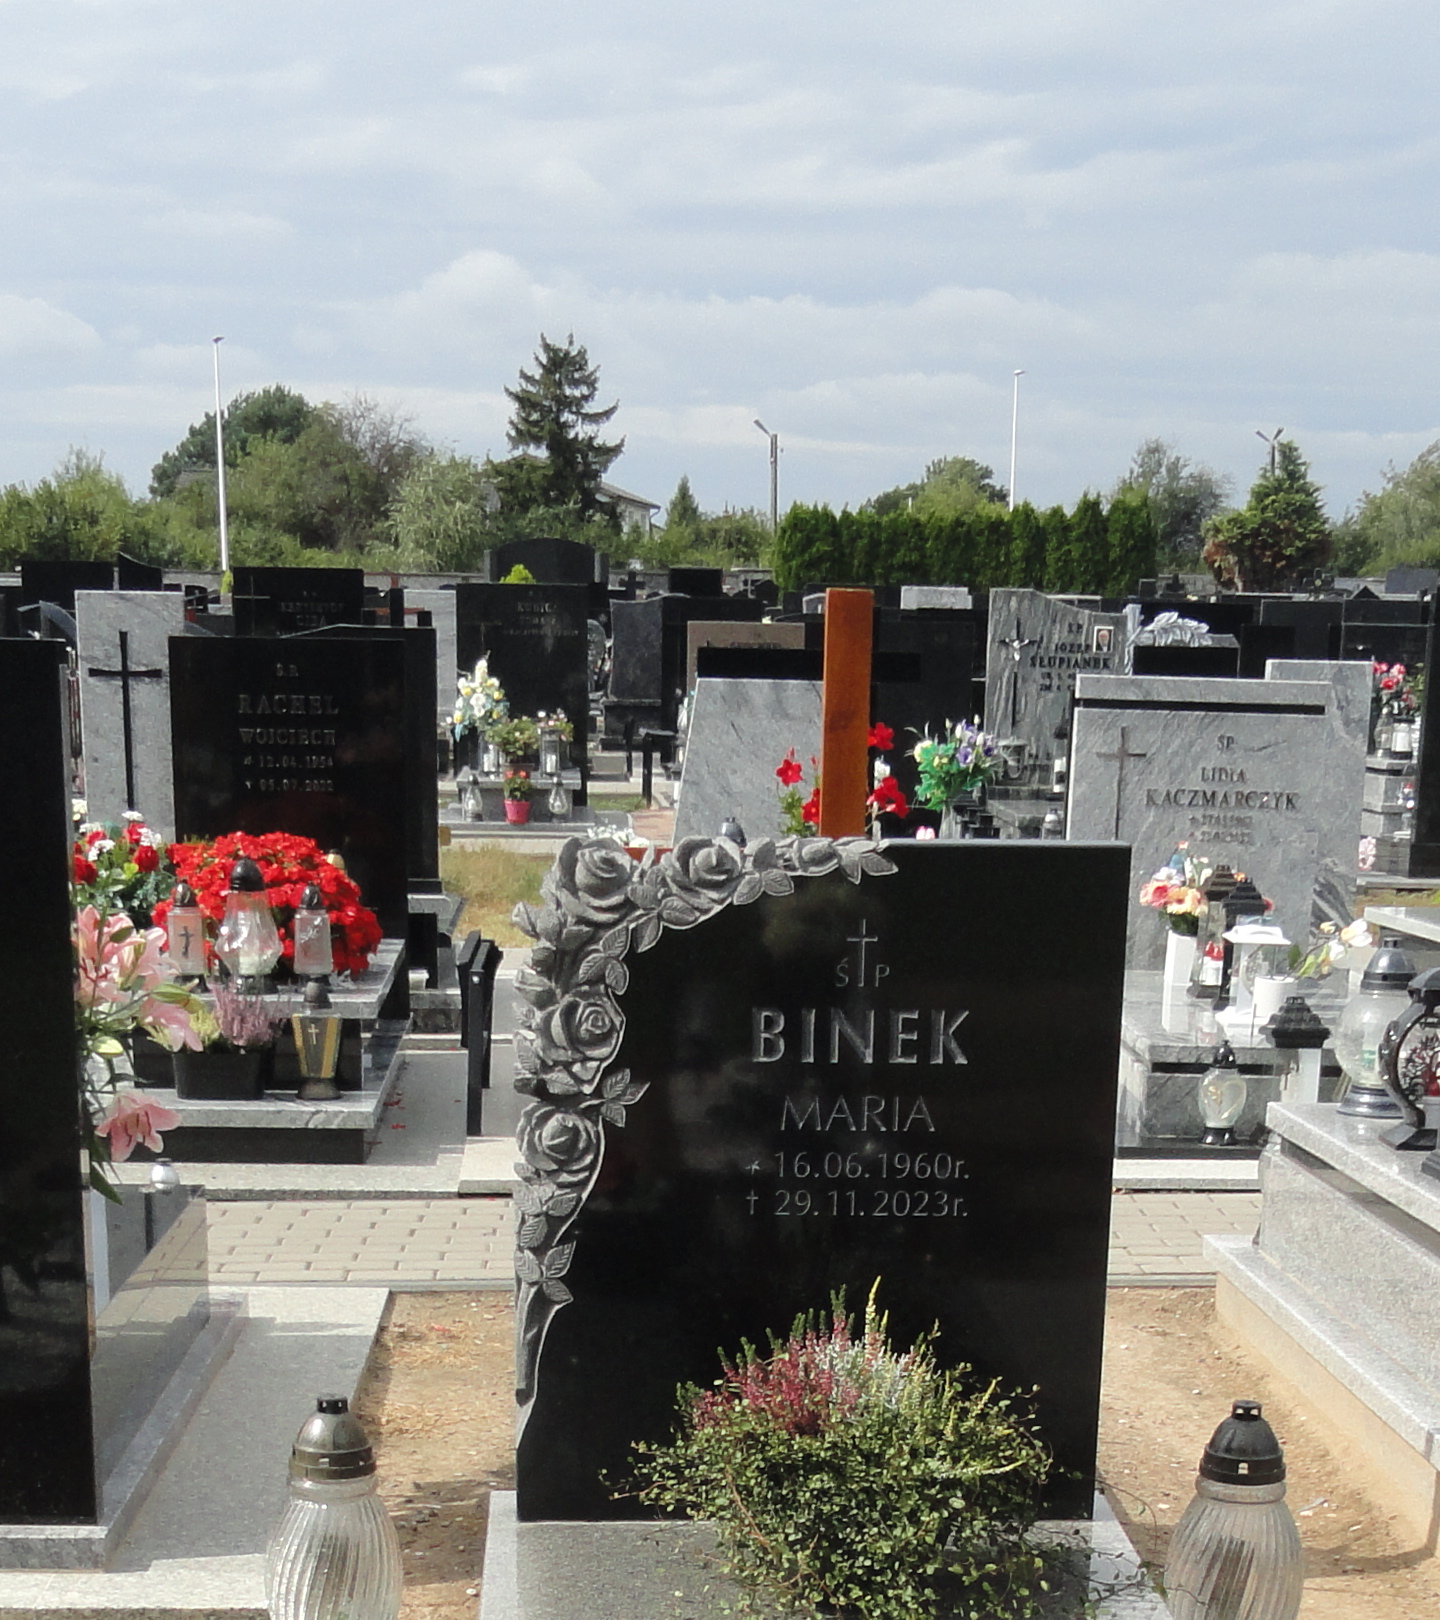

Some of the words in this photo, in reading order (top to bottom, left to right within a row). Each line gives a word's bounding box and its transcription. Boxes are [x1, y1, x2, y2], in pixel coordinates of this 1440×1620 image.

[238, 694, 339, 715] RACHEL
[239, 728, 336, 746] WOJCIECH
[1201, 766, 1247, 784] LIDIA
[1146, 788, 1300, 811] KACZMARCZYK
[875, 964, 890, 987] P
[751, 1007, 970, 1064] BINEK
[780, 1095, 936, 1132] MARIA
[774, 1152, 969, 1179] 16.06.1960r.
[774, 1190, 969, 1217] 29.11.2023r.
